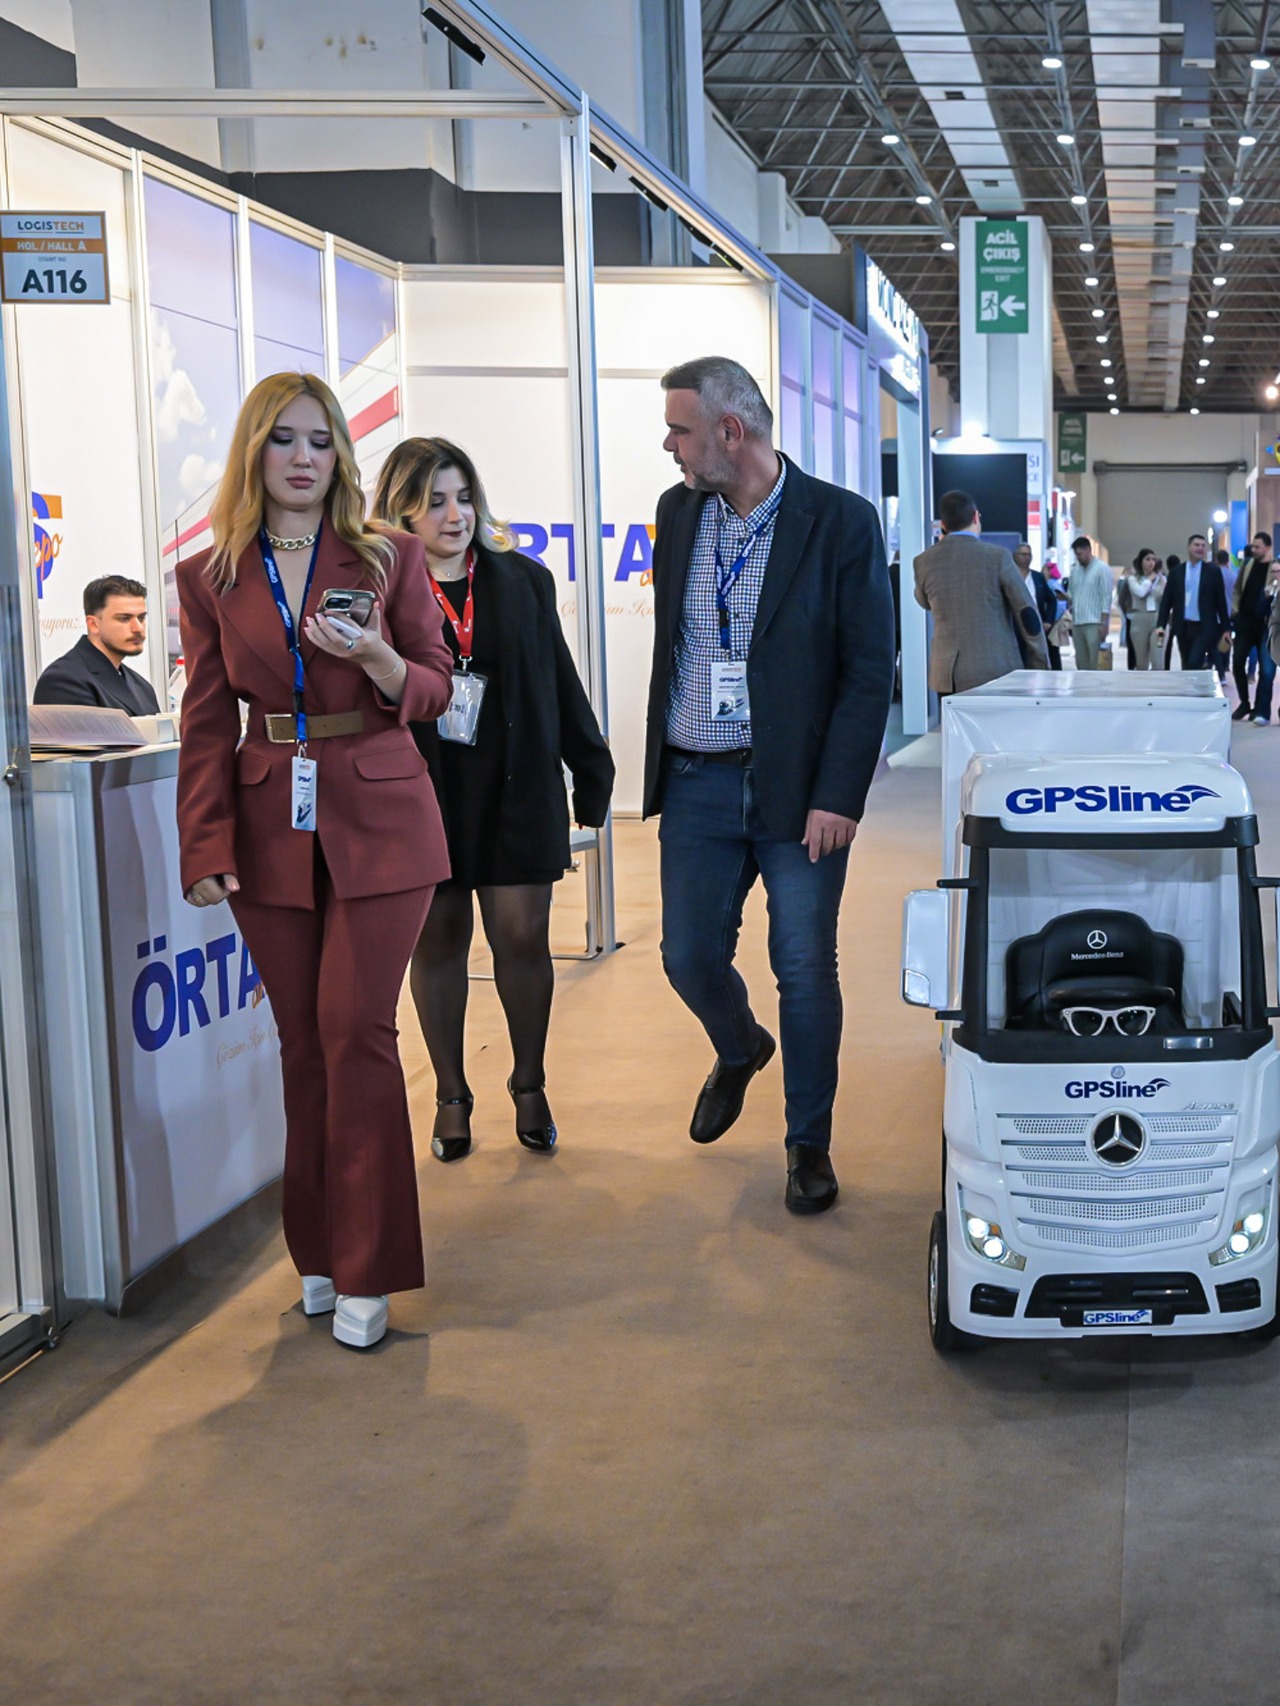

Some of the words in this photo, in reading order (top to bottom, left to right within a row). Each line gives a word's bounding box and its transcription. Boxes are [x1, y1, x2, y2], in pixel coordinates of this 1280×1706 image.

[17, 221, 84, 231] LOGISTECH
[47, 242, 75, 251] HALL
[77, 240, 87, 251] A
[983, 247, 1021, 262] ÇIKIŞ
[21, 269, 88, 294] A116
[1005, 785, 1192, 815] GPSline
[1070, 951, 1124, 961] Mercedes-Benz
[1065, 1080, 1157, 1099] GPSline
[1084, 1311, 1141, 1324] GPSline
